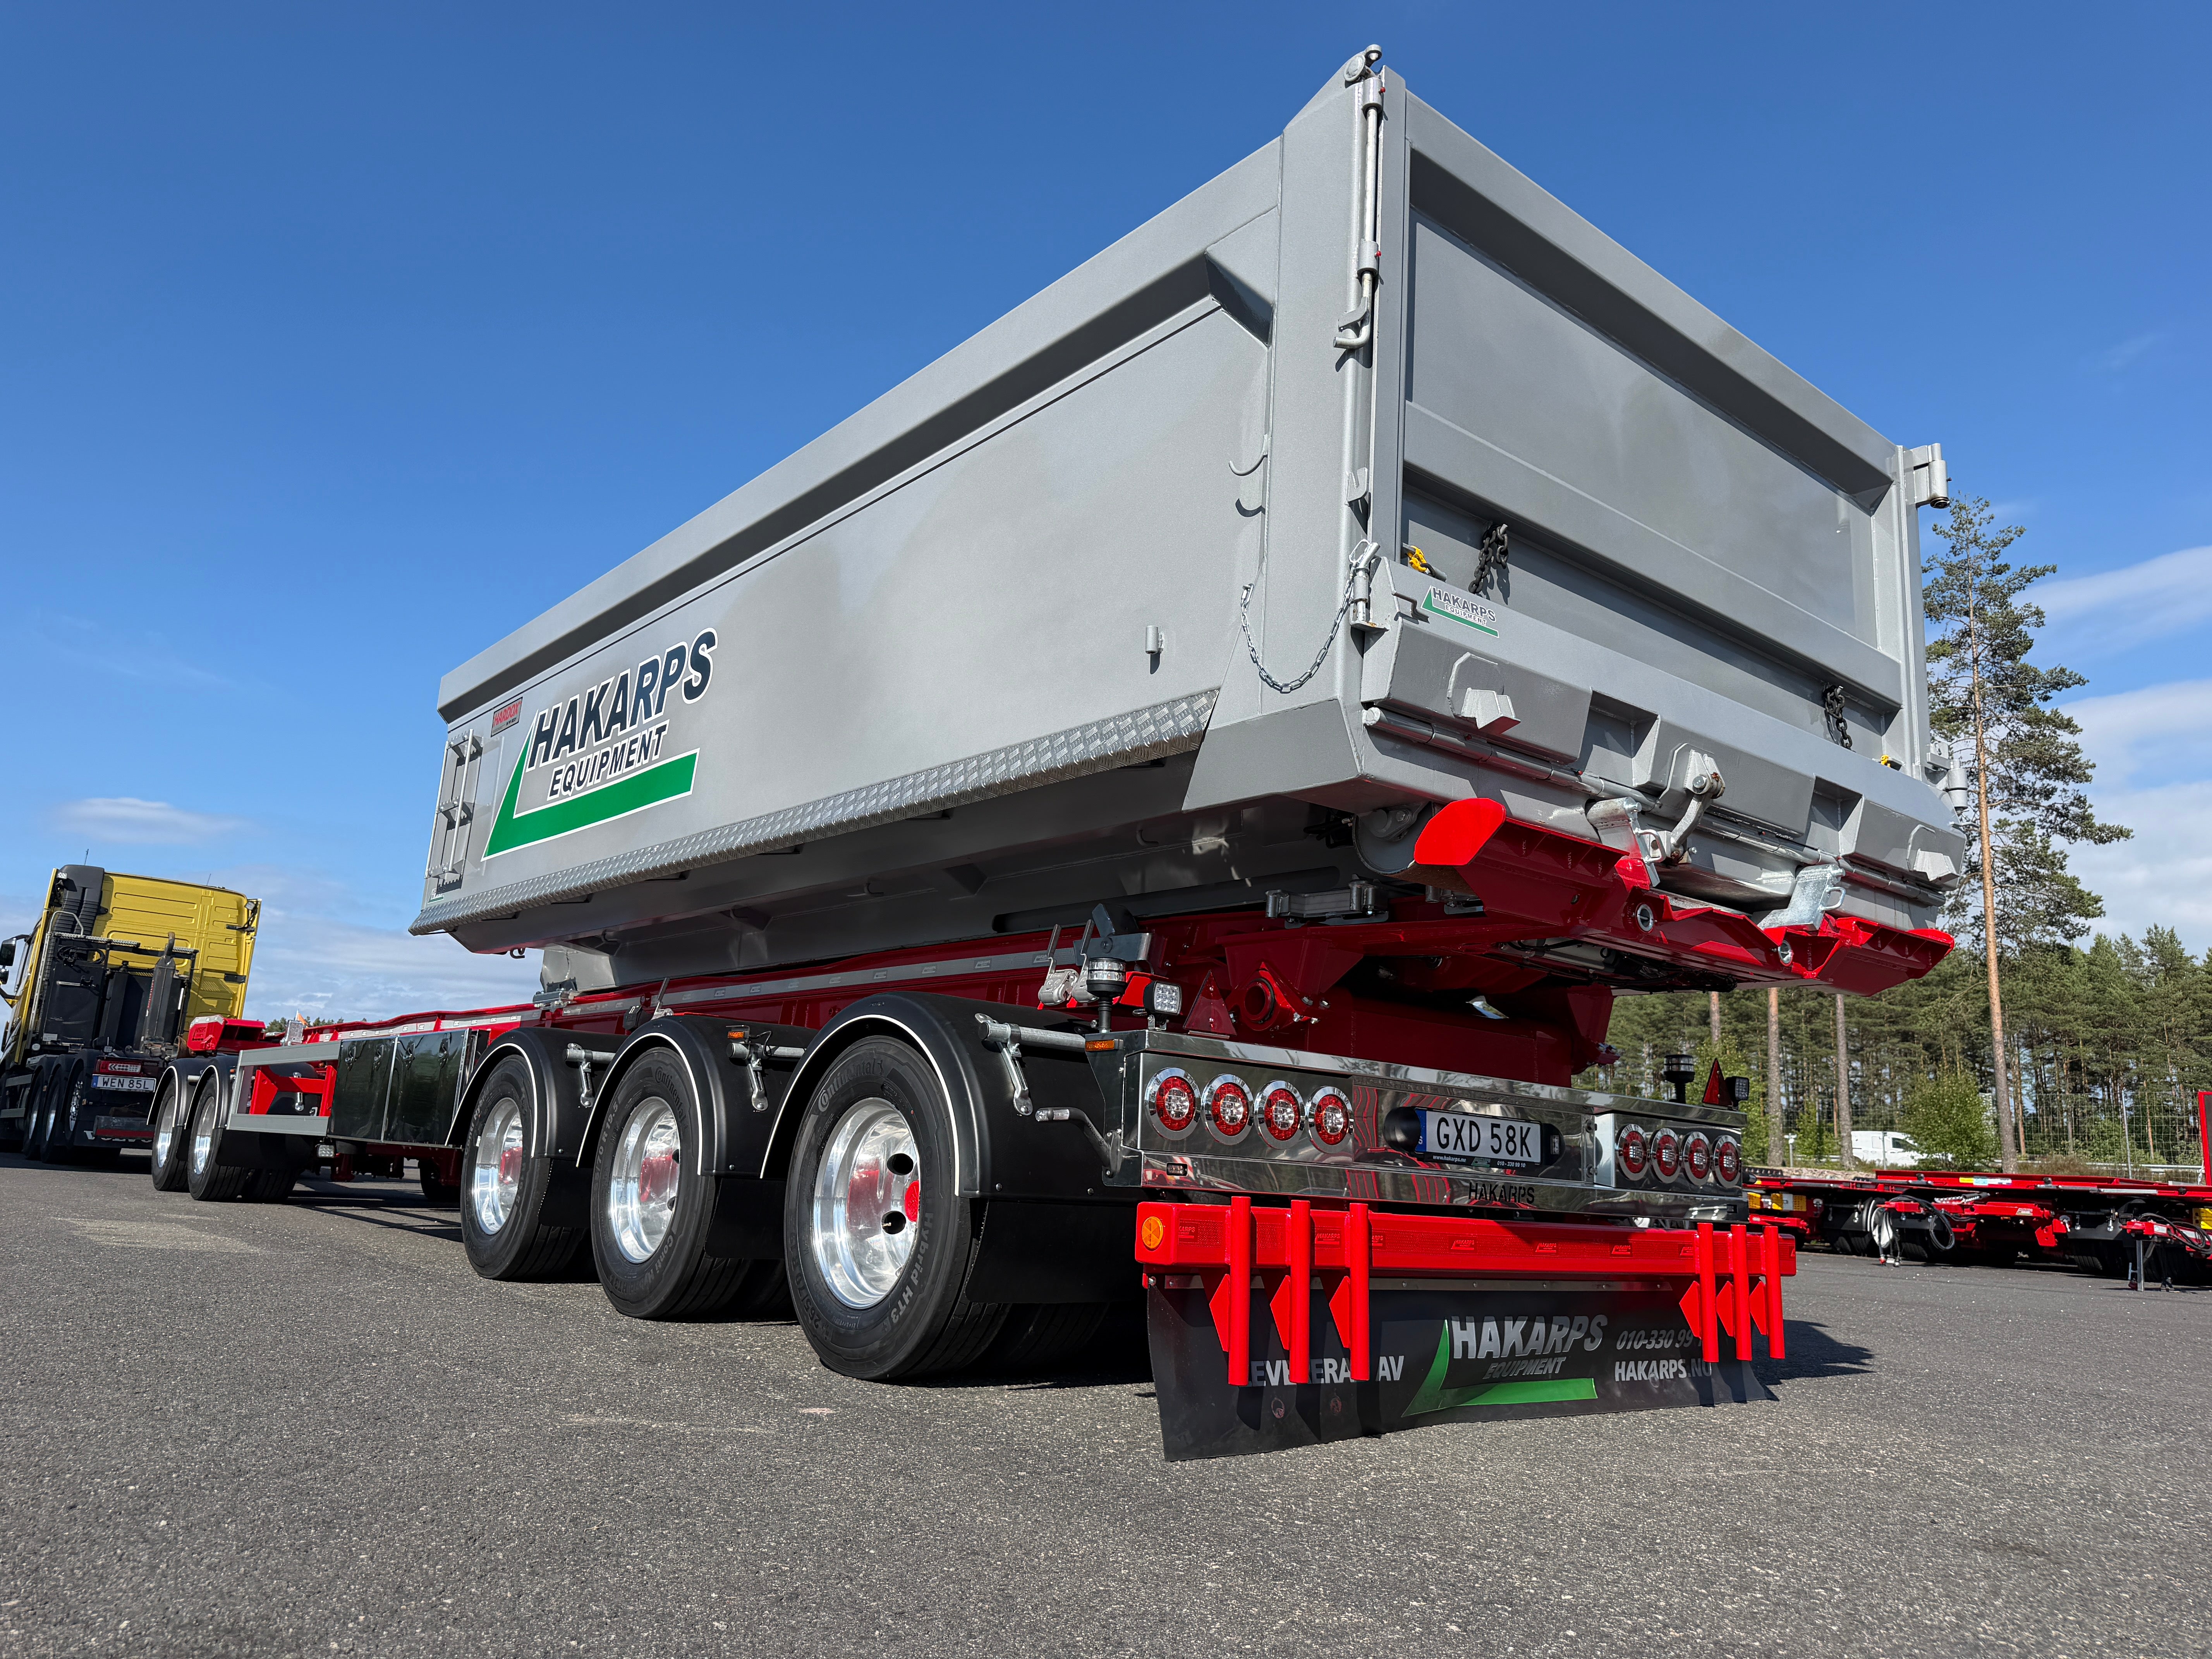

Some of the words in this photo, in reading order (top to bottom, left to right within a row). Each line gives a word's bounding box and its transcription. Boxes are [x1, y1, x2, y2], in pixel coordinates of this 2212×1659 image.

[1432, 587, 1496, 622] HAKARPS
[1445, 604, 1487, 625] EQUIPMENT
[493, 702, 520, 727] HARDOX
[527, 629, 717, 771] HAKARPS
[548, 721, 668, 799] EQUIPMENT
[103, 1077, 124, 1087] WEN
[128, 1079, 149, 1089] 85L
[655, 1066, 686, 1122] Continental
[818, 1058, 876, 1112] Continental
[606, 1101, 618, 1129] 19.5
[1437, 1117, 1480, 1152] GXD
[1491, 1123, 1532, 1158] 58K
[1469, 1182, 1535, 1204] HAKARPS
[655, 1235, 673, 1273] Conti
[911, 1212, 934, 1285] Hybrid
[891, 1285, 913, 1323] HT3
[1451, 1314, 1608, 1358] HAKARPS
[1616, 1329, 1674, 1350] 010-330
[1675, 1329, 1694, 1348] 99
[1376, 1355, 1404, 1381] AV
[1482, 1357, 1566, 1379] EQUIPMENT
[1615, 1358, 1712, 1381] HAKARPS.NU
